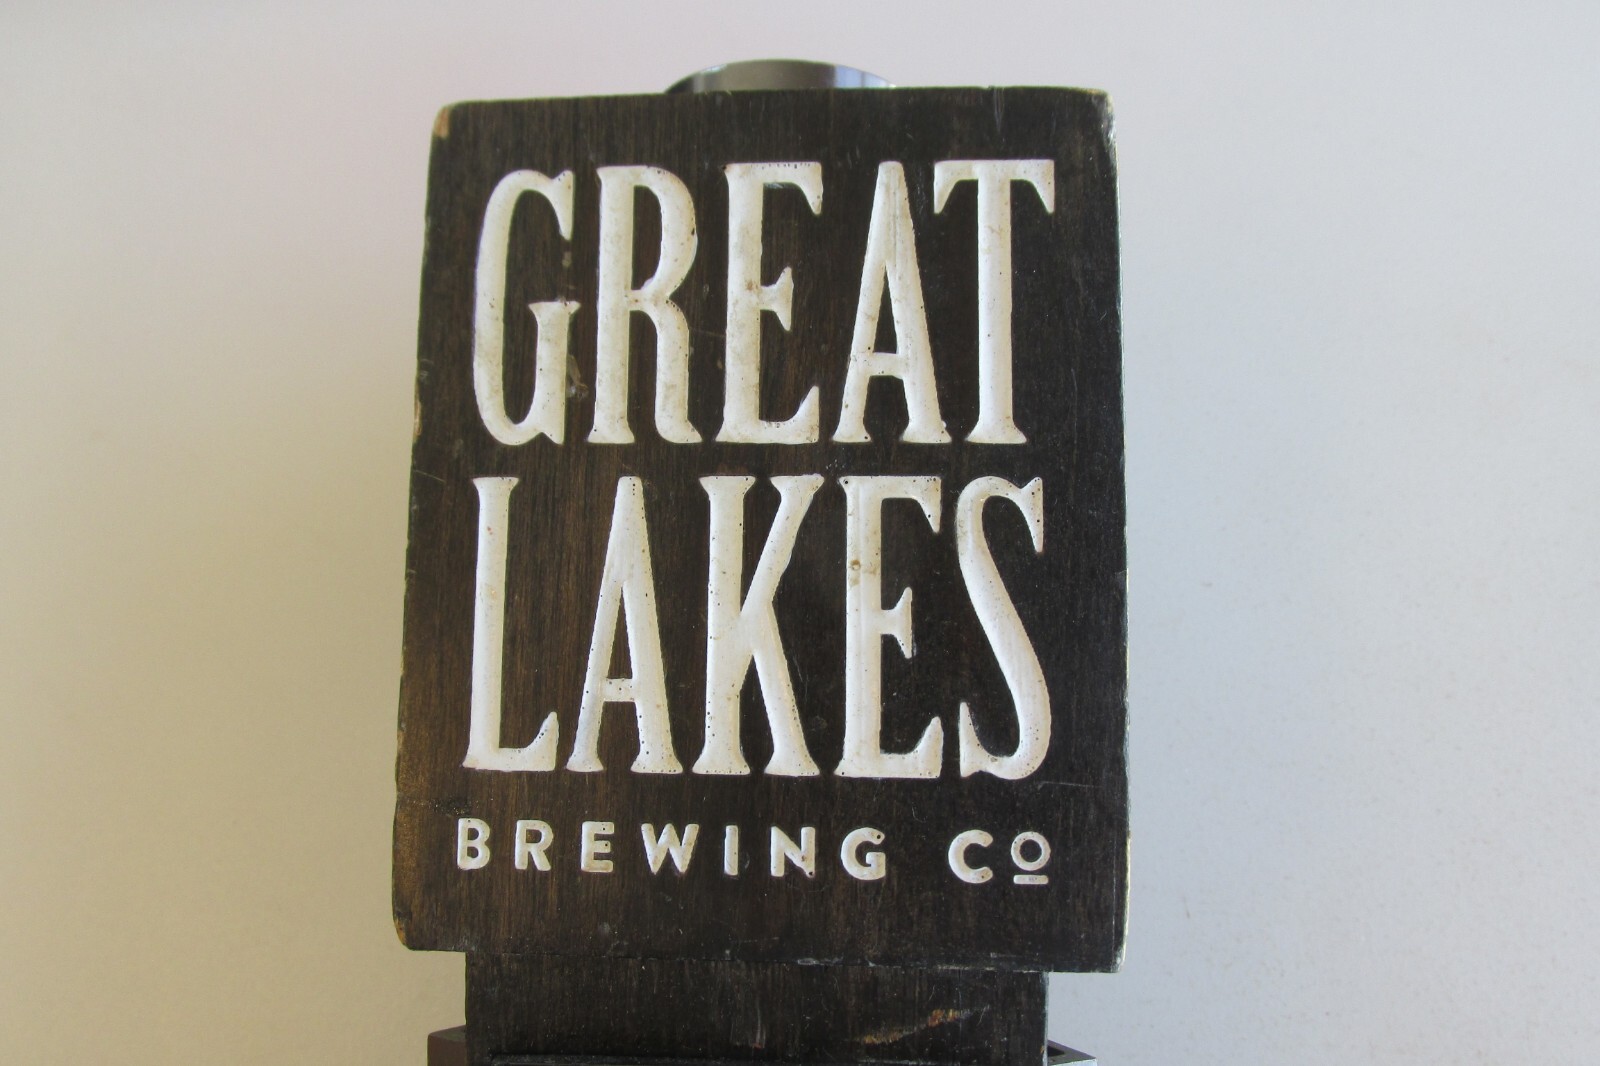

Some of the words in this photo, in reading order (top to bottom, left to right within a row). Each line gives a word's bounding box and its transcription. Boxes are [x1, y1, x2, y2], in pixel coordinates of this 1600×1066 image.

[472, 158, 1056, 447] GREAT
[462, 475, 1052, 781] LAKES
[455, 817, 887, 882] BREWING
